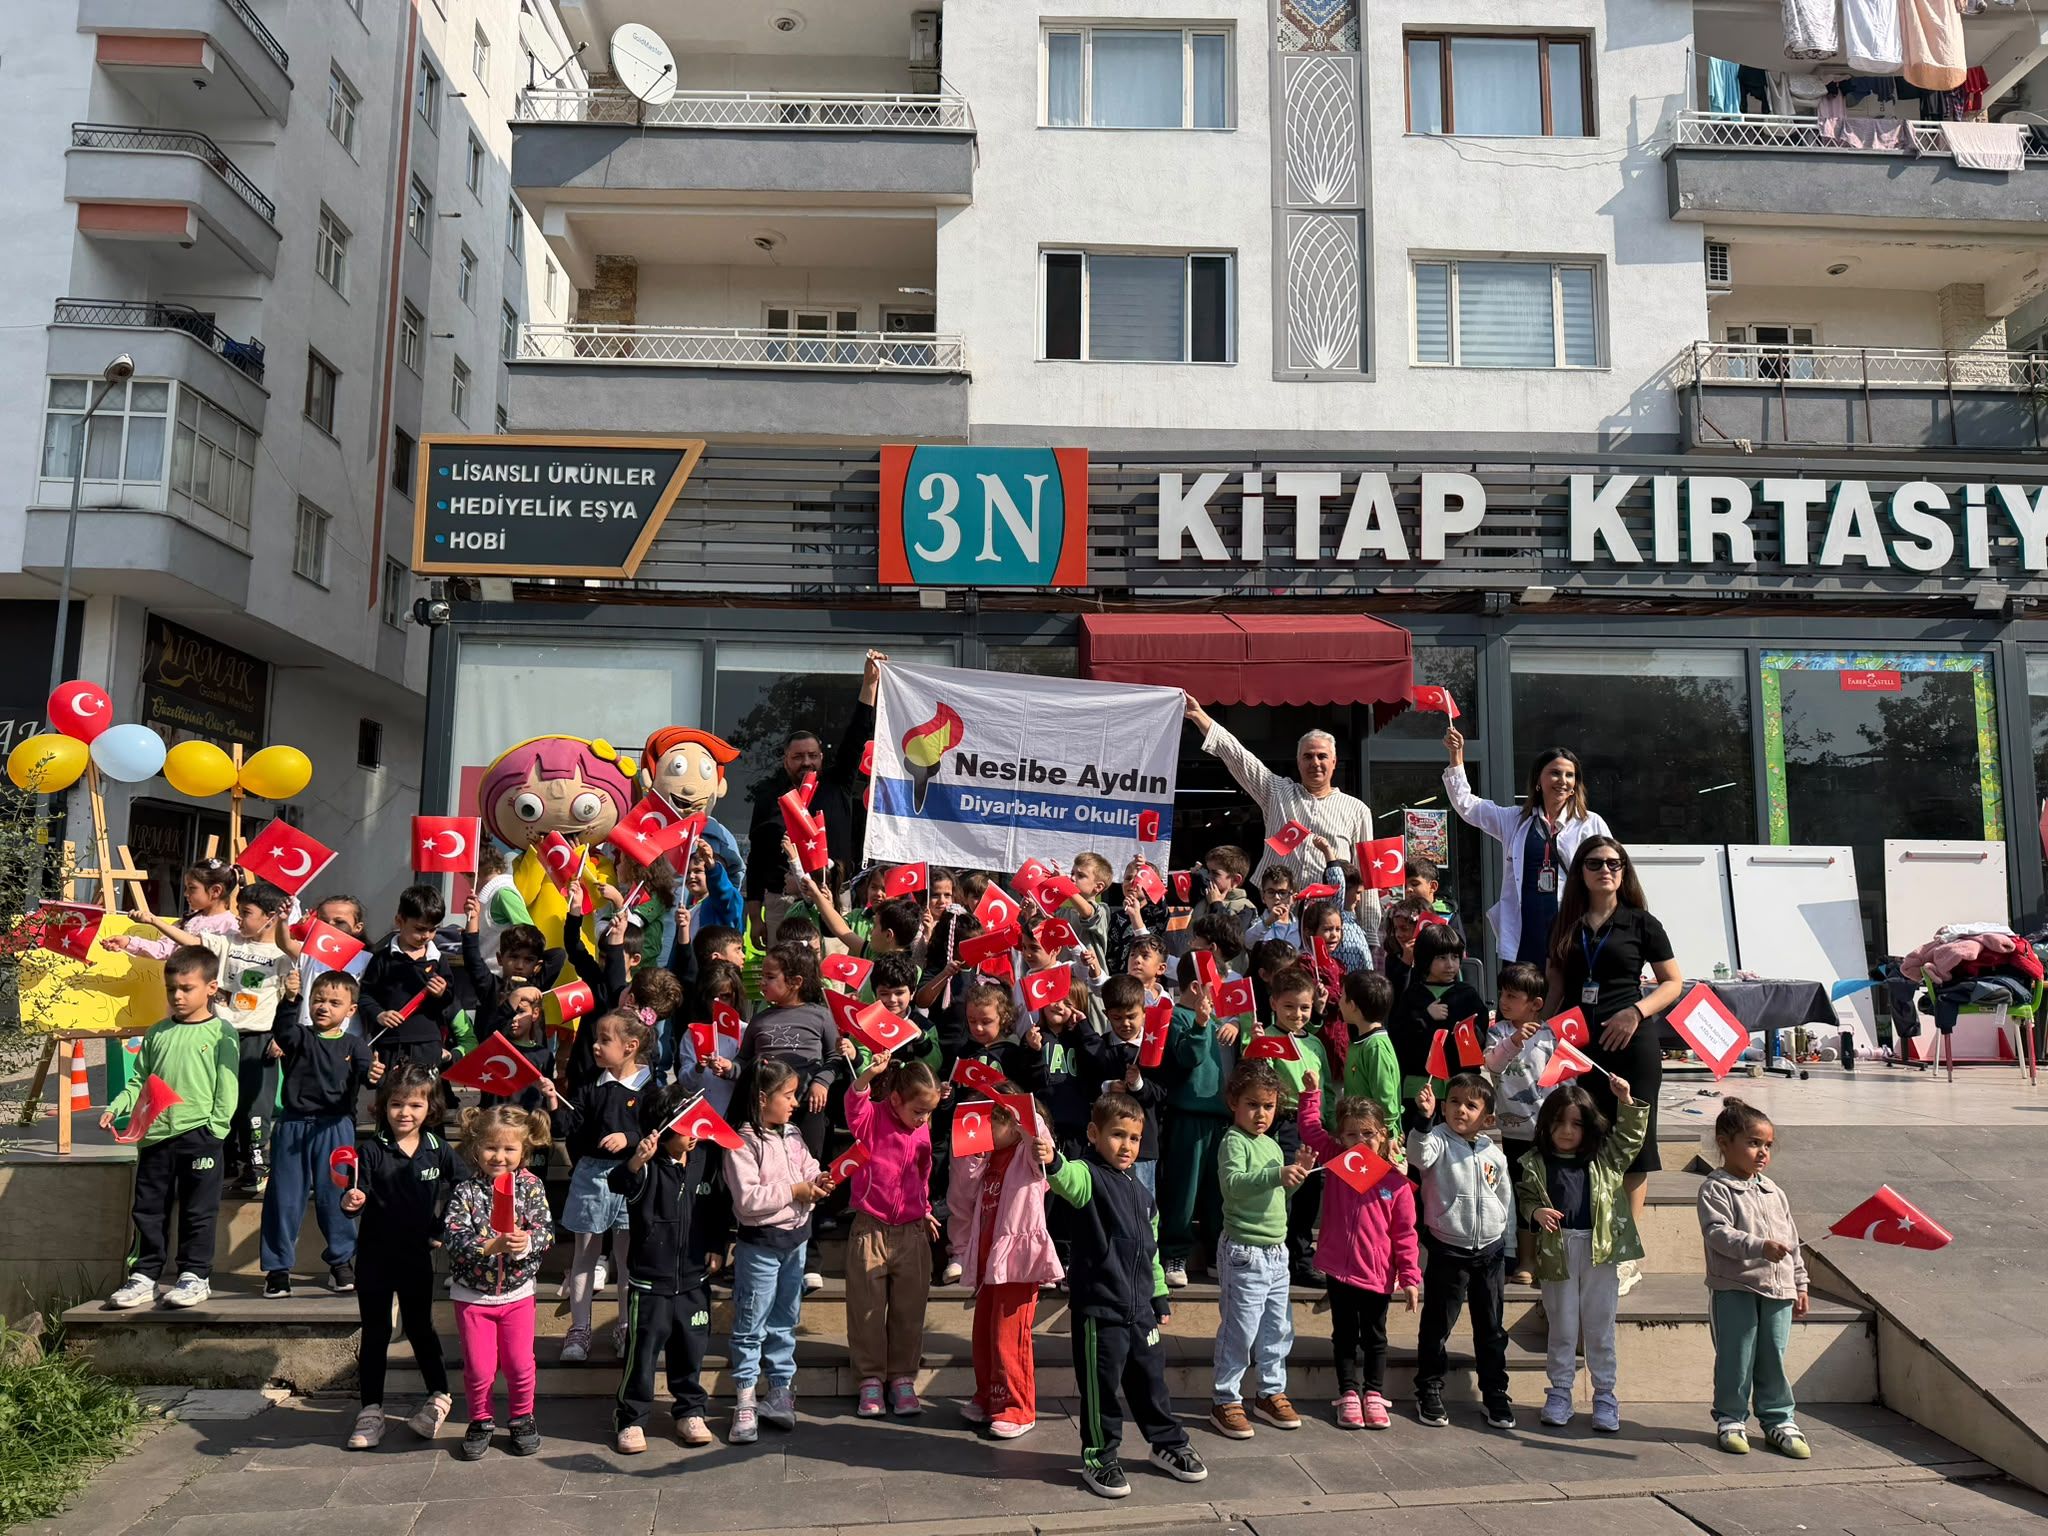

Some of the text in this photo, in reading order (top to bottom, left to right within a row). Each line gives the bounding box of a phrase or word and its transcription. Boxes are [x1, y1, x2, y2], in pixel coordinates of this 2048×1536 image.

[451, 459, 657, 486] LİSANSLI ÜRÜNLER
[450, 493, 638, 523] HEDİYELİK EŞYA
[913, 472, 1049, 563] 3N
[450, 528, 506, 550] HOBİ
[170, 635, 255, 702] IRMAK
[955, 752, 1168, 795] Nesibe Aydın
[960, 793, 1139, 827] Diyarbakır Okulla
